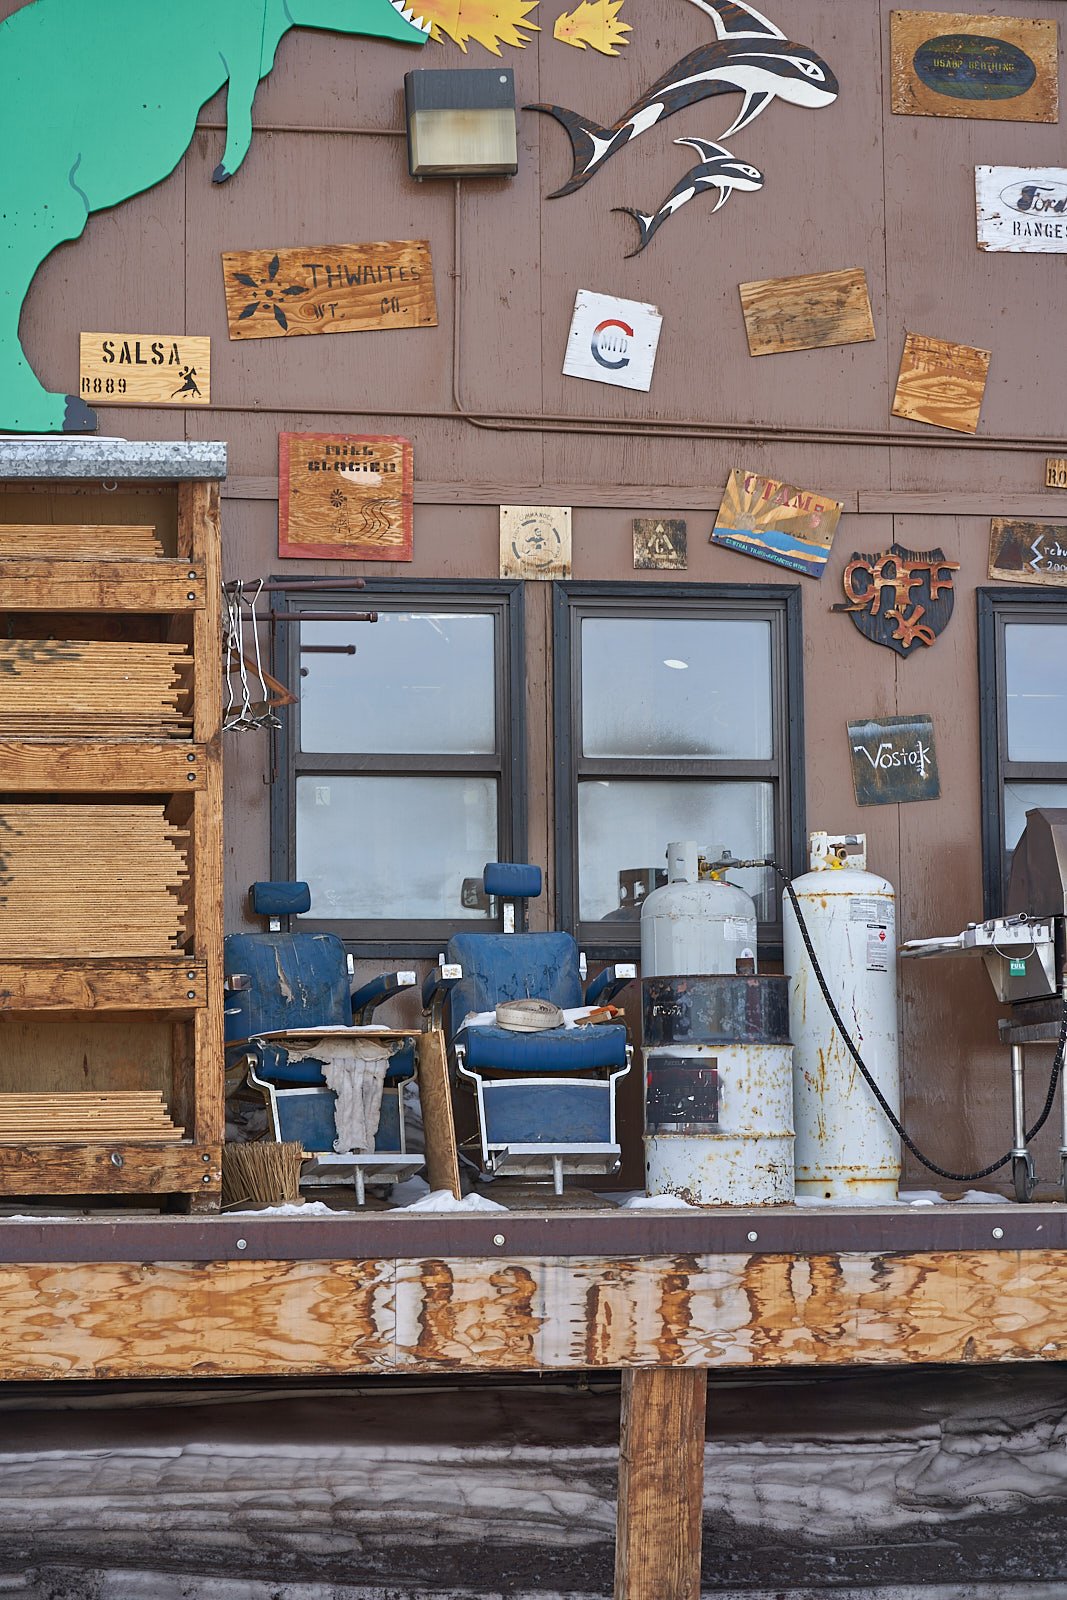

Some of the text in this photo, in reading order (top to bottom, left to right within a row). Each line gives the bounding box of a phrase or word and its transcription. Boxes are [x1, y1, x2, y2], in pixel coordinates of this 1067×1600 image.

[302, 263, 421, 289] THWAITES
[102, 341, 181, 365] SALSA
[725, 538, 748, 551] CENTRAL
[853, 740, 931, 778] Vostok
